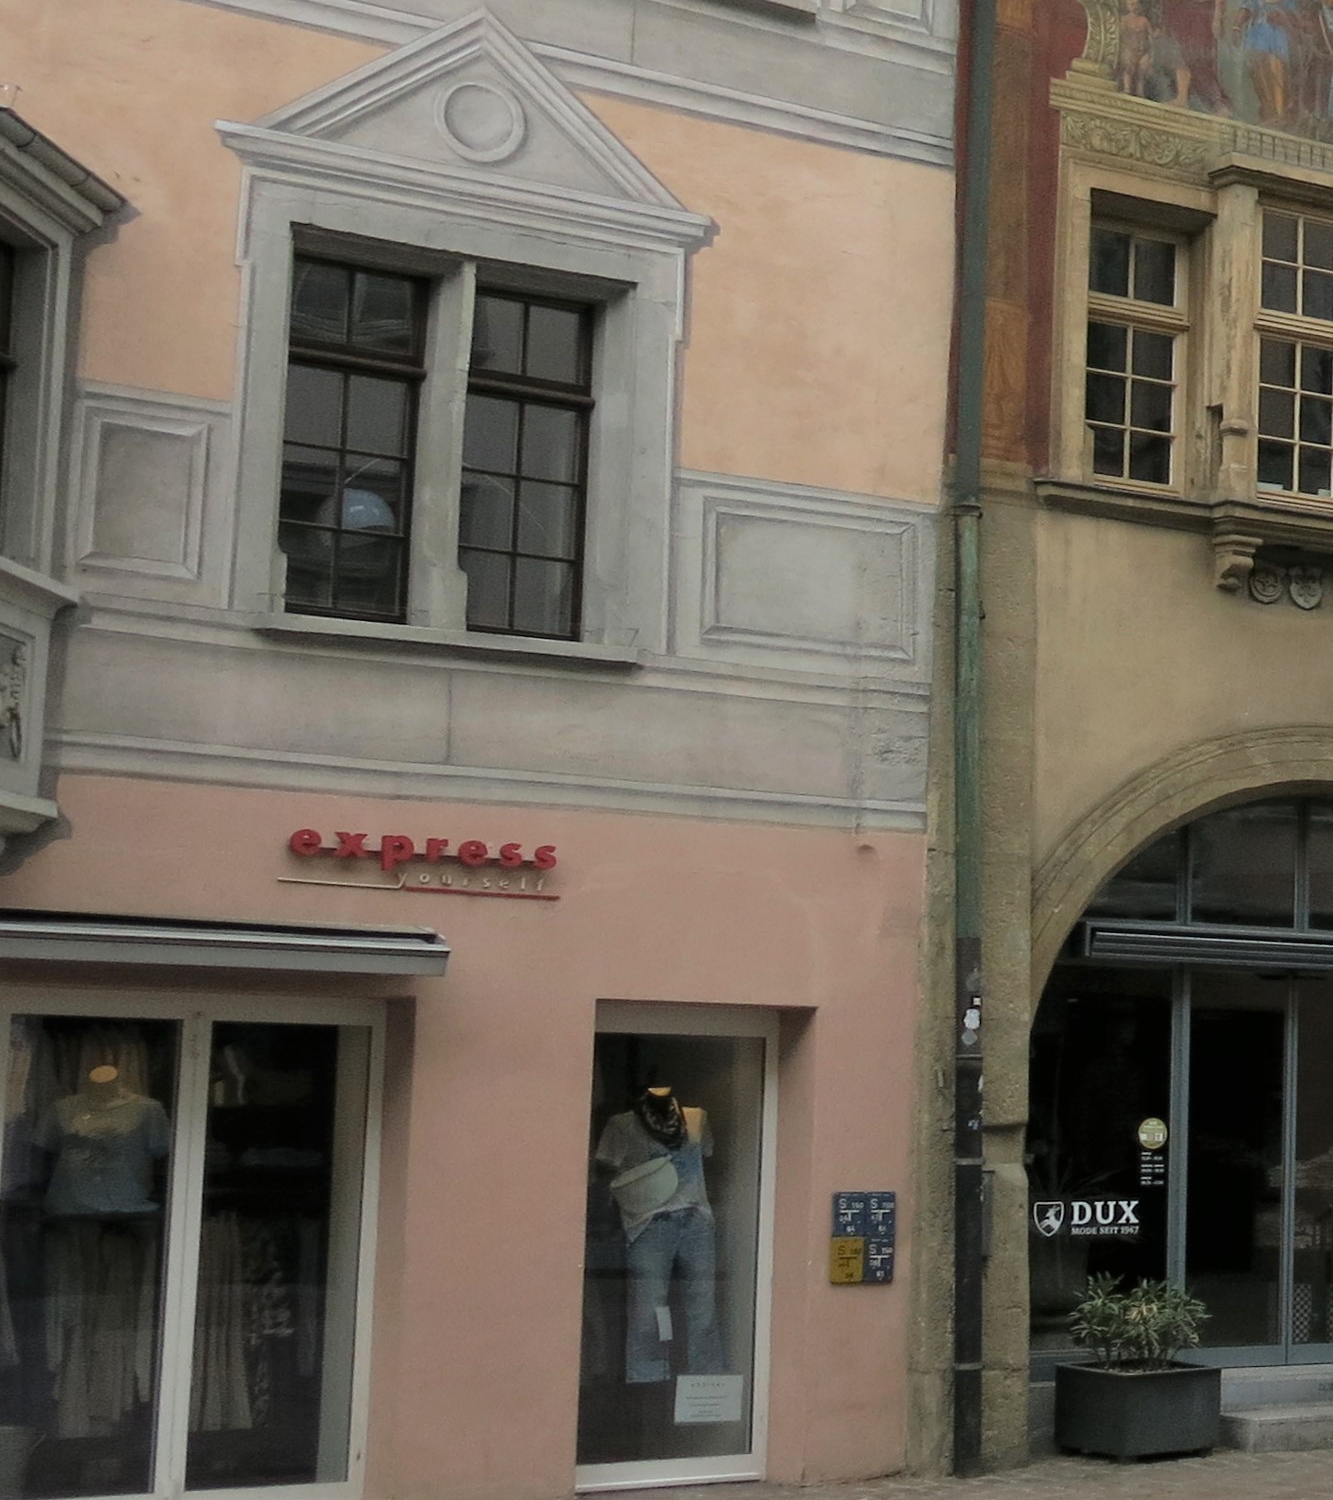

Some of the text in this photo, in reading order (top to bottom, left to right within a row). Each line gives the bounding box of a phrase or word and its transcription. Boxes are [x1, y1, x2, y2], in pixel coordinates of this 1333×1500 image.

[289, 828, 557, 871] express
[397, 873, 545, 891] yourself
[839, 1198, 847, 1209] S
[870, 1198, 878, 1209] S
[1071, 1200, 1139, 1225] DUX
[1071, 1227, 1097, 1235] MODE
[1100, 1226, 1118, 1235] SEIT
[869, 1244, 877, 1254] S
